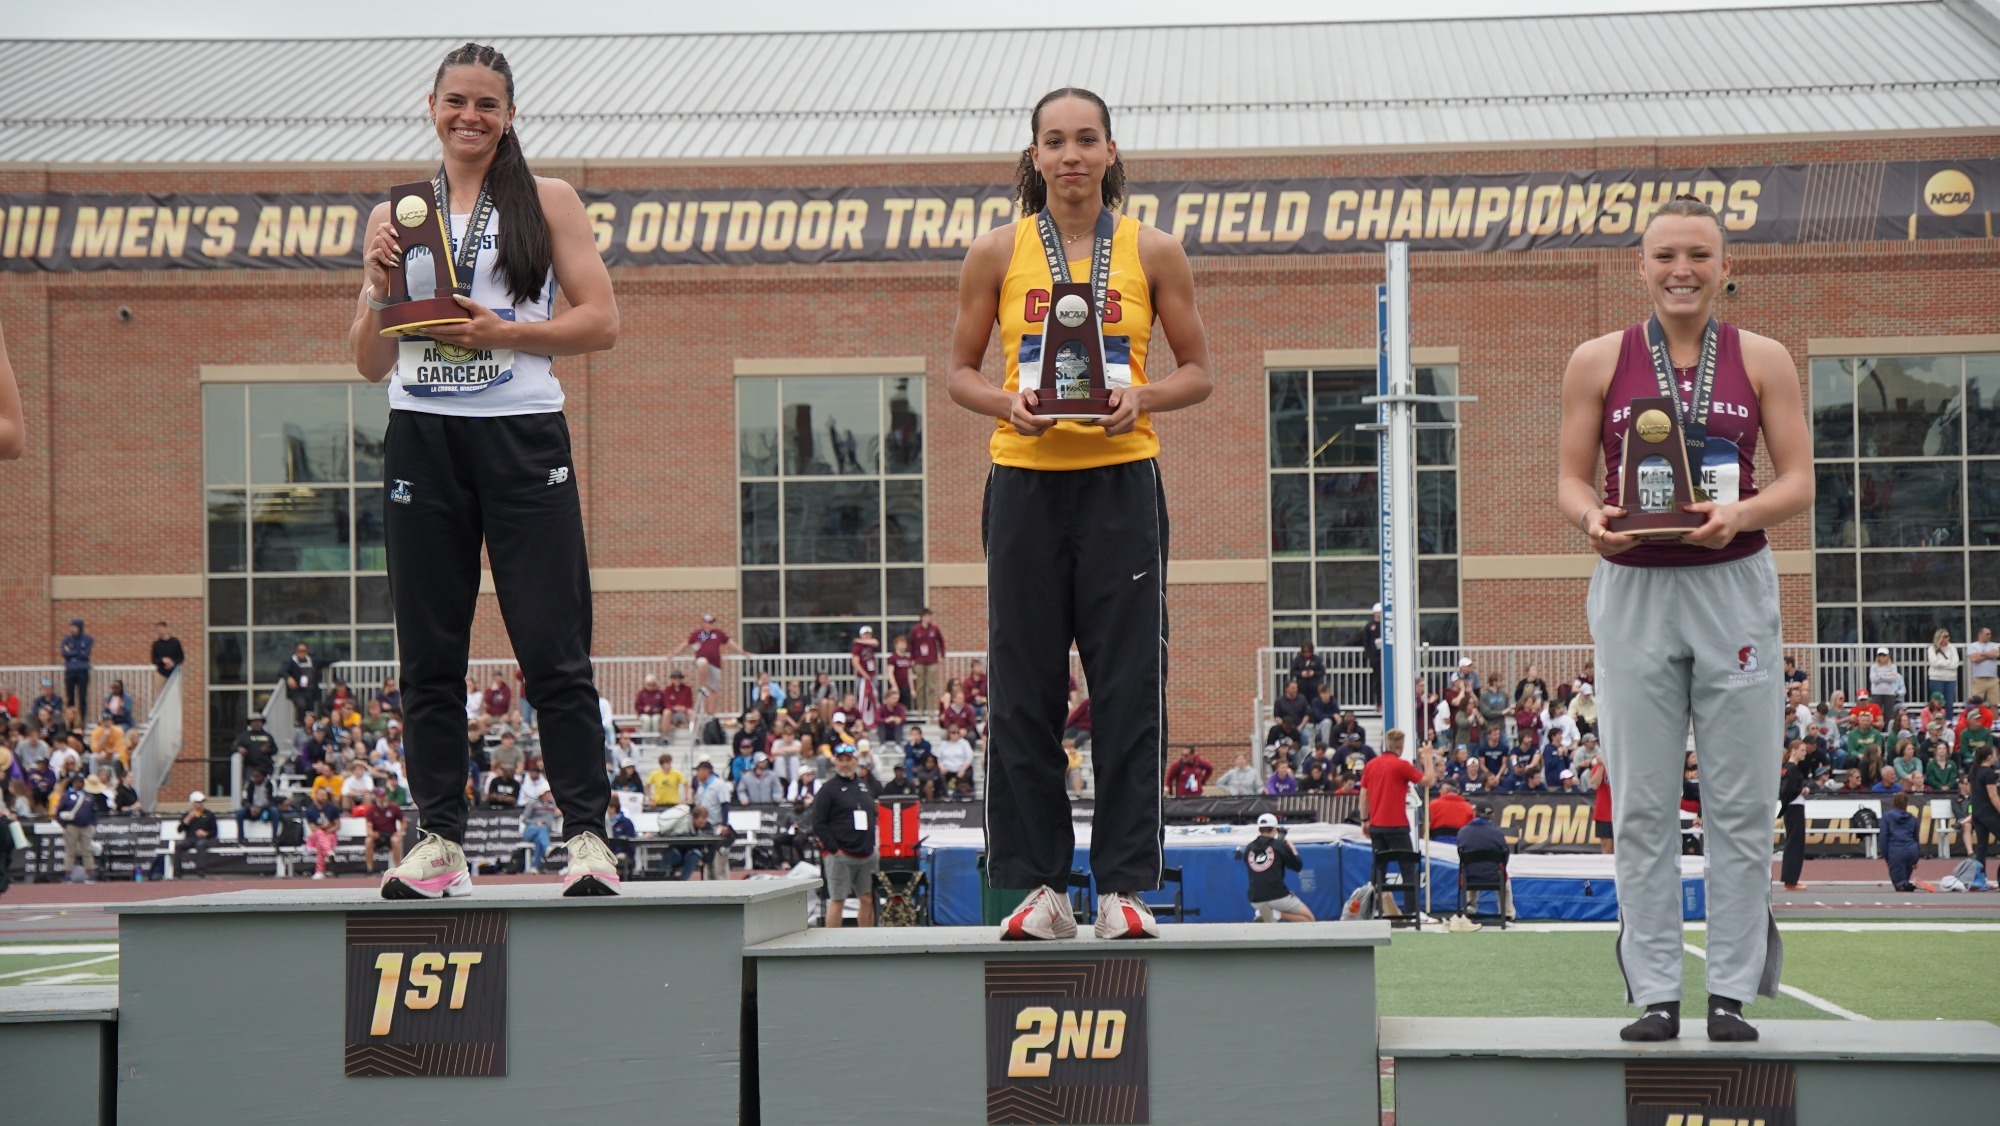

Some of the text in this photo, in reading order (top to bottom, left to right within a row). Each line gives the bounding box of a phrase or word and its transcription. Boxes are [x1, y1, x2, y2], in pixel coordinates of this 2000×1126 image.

[1171, 189, 1312, 243] FIELD
[1930, 192, 1970, 205] NCAA
[70, 205, 240, 258] MEN'S
[248, 205, 359, 258] AND
[463, 231, 472, 252] DIVISION
[470, 203, 482, 227] OUTDOOR
[625, 199, 869, 253] OUTDOOR
[883, 197, 1023, 249] TRAC
[1059, 310, 1086, 320] NCAA
[417, 364, 499, 383] GARCEAU
[1692, 386, 1701, 408] DIVISION
[1697, 356, 1706, 381] OUTDOOR
[1697, 331, 1718, 426] ALL-AMERICAN
[1381, 402, 1392, 513] CHAMPIONSIPS
[1686, 440, 1705, 448] 2026
[1383, 515, 1392, 550] FIELD
[1383, 562, 1393, 606] TRACK
[1384, 611, 1394, 645] NCAA
[892, 802, 902, 843] BODYARMOR
[370, 952, 483, 1036] 1ST
[1007, 1006, 1127, 1078] 2ND
